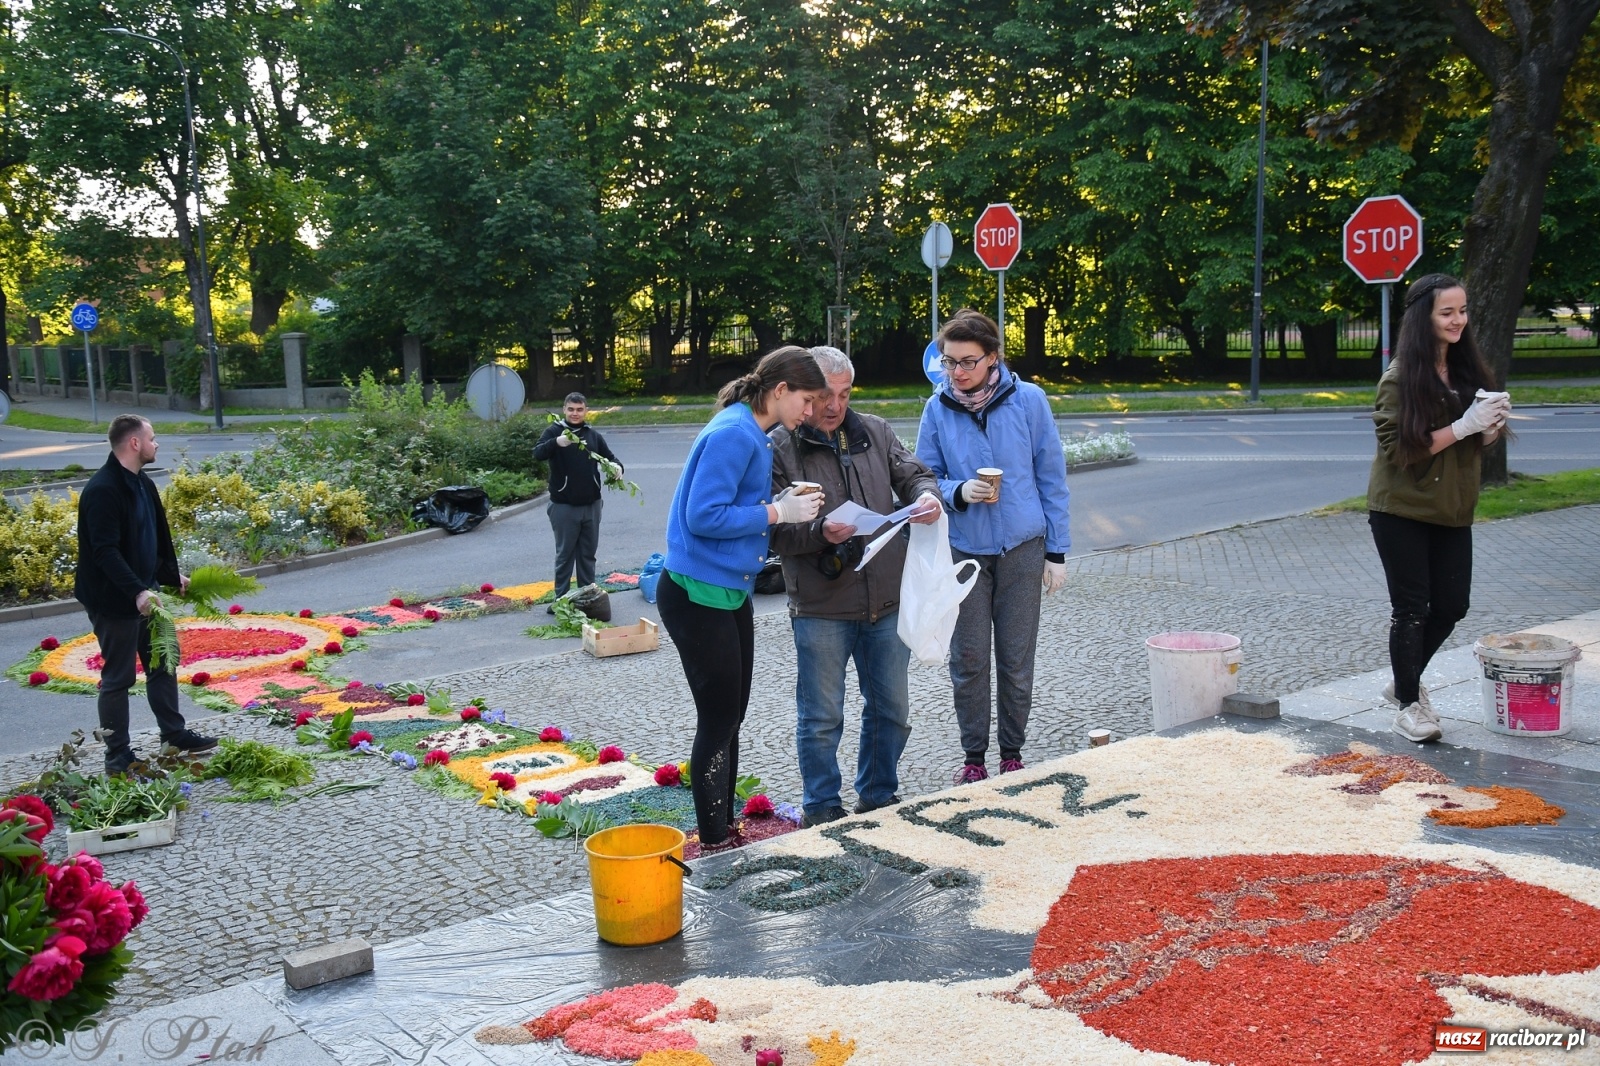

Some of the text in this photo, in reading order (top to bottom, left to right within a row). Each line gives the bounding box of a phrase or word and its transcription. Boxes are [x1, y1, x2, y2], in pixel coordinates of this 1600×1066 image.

[980, 226, 1016, 248] STOP
[1353, 225, 1413, 254] STOP
[1499, 673, 1543, 684] Ceresit
[1495, 682, 1504, 700] 174
